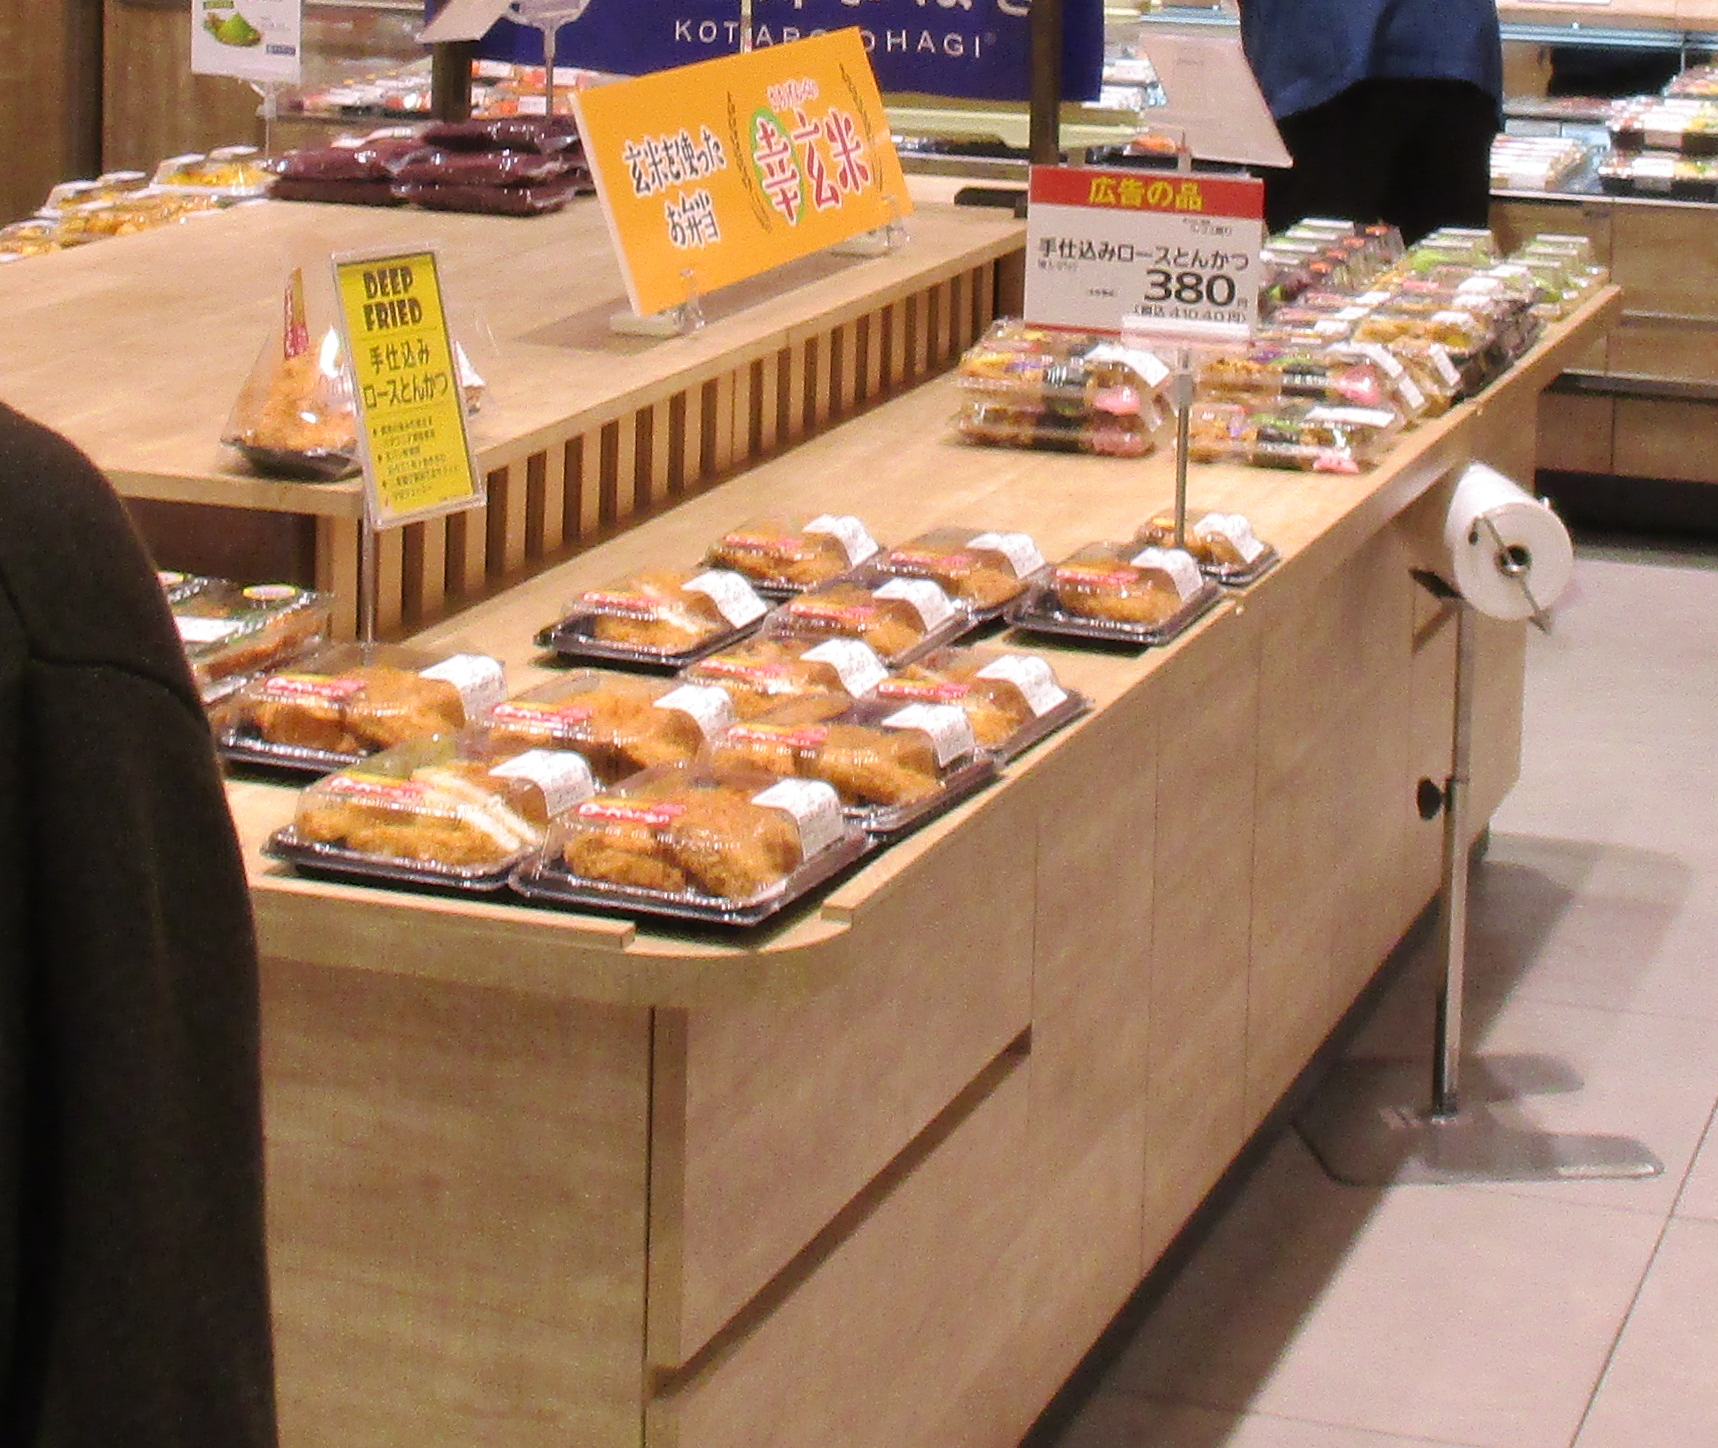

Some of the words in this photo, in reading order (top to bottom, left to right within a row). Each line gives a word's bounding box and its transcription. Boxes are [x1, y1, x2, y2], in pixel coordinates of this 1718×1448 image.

[674, 18, 828, 49] KOTAR
[861, 29, 982, 59] OHAGI
[623, 125, 729, 197] 玄米を使った
[1088, 176, 1204, 211] 広告の品
[664, 188, 721, 250] お弁当
[1039, 236, 1250, 271] 手仕込みロースとんかつ
[363, 265, 414, 300] DEEP
[363, 296, 423, 332] FRIED
[369, 338, 431, 377] 手仕込み
[363, 372, 449, 410] ロースとんかつ
